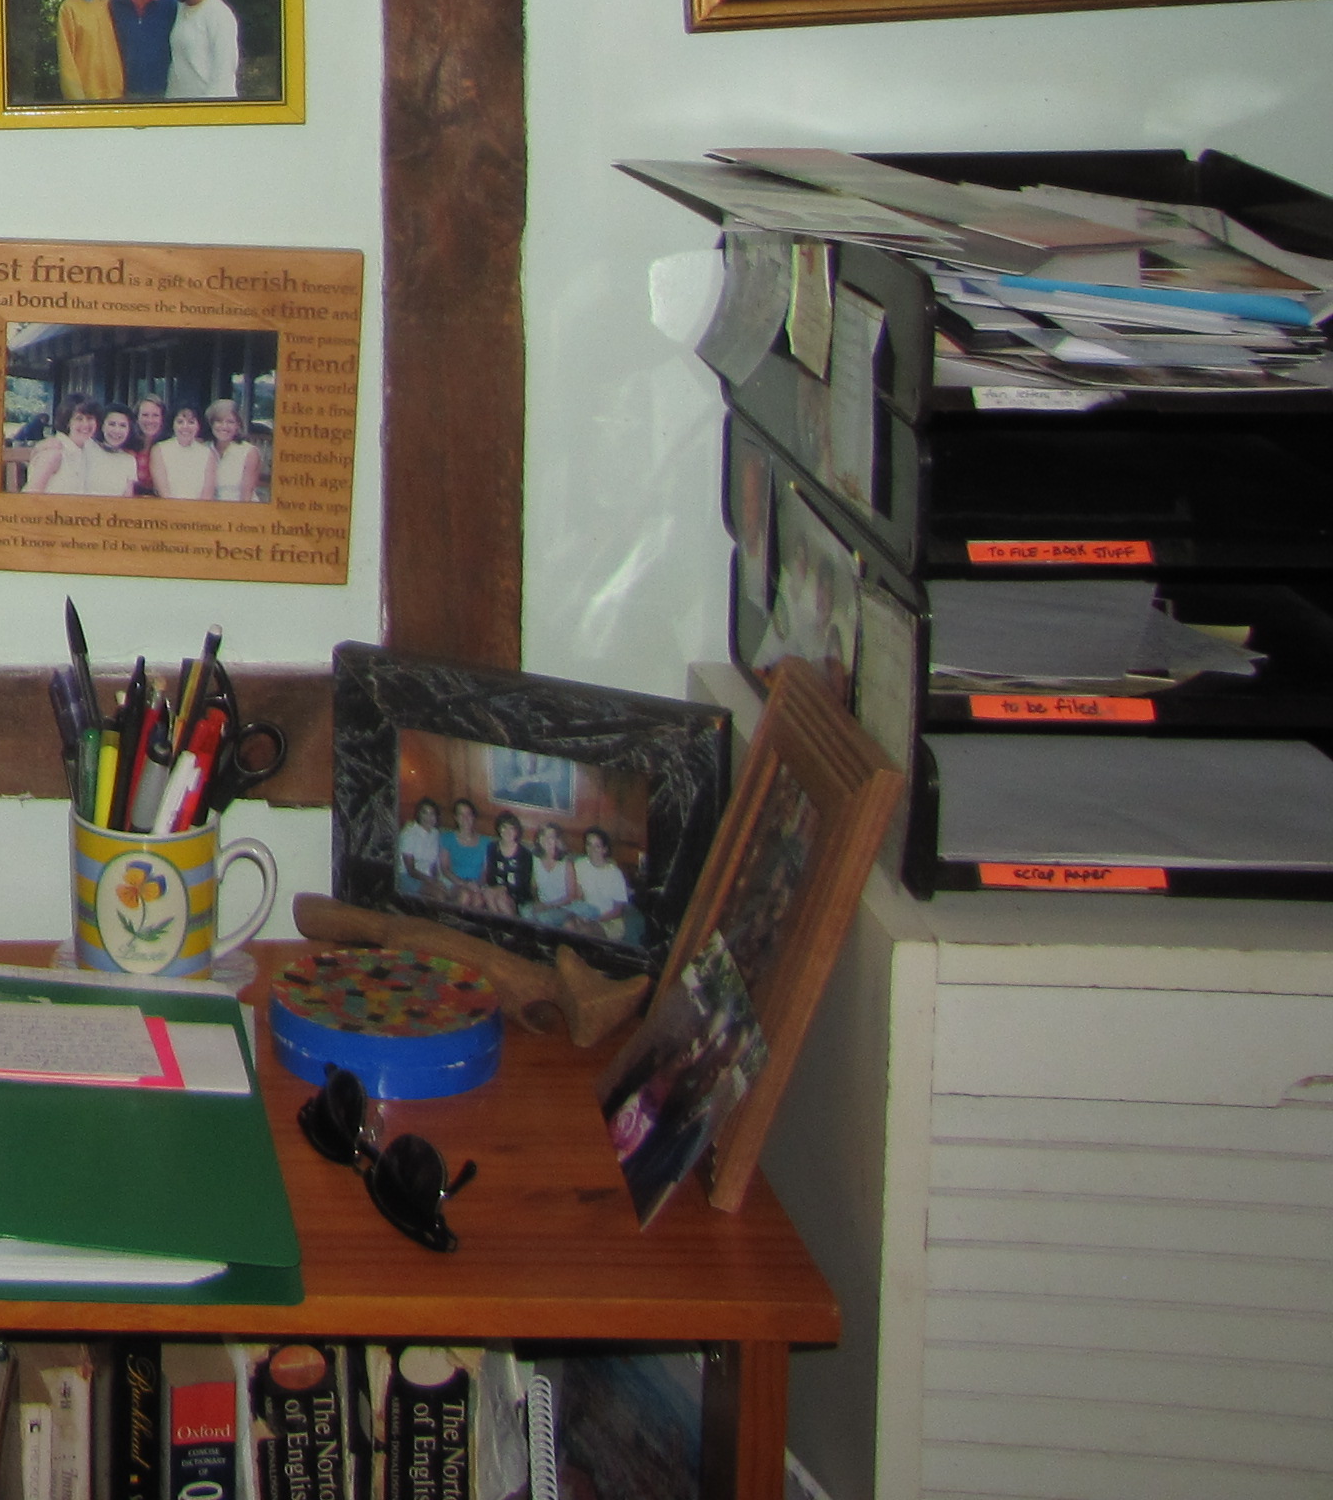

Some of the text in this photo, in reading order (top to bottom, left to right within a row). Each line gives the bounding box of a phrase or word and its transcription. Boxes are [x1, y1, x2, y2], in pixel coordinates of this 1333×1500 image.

[31, 255, 125, 284] friend
[129, 275, 140, 287] is
[145, 278, 153, 287] a
[158, 275, 183, 290] gift
[188, 278, 202, 289] to
[206, 267, 298, 292] cherish
[302, 281, 358, 295] forever.
[17, 290, 68, 309] bond
[71, 298, 98, 310] that
[102, 302, 150, 312] crosses
[155, 301, 176, 313] the
[180, 302, 258, 316] boundaries
[262, 303, 275, 316] of
[280, 301, 329, 320] time
[332, 308, 358, 321] and
[284, 332, 314, 343] Time
[285, 351, 357, 374] friend
[284, 382, 356, 395] in a world
[282, 402, 354, 417] Like a fine
[281, 423, 353, 446] vintage
[279, 451, 352, 469] friendship
[277, 474, 315, 487] with
[276, 497, 348, 515] have its ups
[20, 515, 43, 525] our
[45, 510, 102, 528] shared
[106, 514, 169, 531] dreams
[227, 522, 232, 533] I
[235, 523, 266, 534] don't
[271, 523, 316, 537] thank
[316, 527, 346, 542] you
[21, 536, 56, 548] know
[60, 538, 99, 550] where
[102, 540, 118, 551] I'd
[121, 540, 134, 551] be
[140, 541, 193, 554] without
[193, 546, 215, 558] my
[214, 540, 263, 561] best
[1010, 547, 1038, 558] FILE
[1092, 546, 1135, 558] STUFF
[1001, 698, 1100, 715] to be filed
[1013, 868, 1113, 883] scrap paper
[126, 1353, 157, 1469] Buckhead
[284, 1399, 306, 1429] of
[313, 1391, 335, 1440] The
[413, 1402, 436, 1430] of
[442, 1400, 466, 1441] The
[177, 1423, 232, 1439] Oxford
[187, 1447, 221, 1456] CONCISE
[181, 1456, 226, 1468] DICTIONARY
[198, 1468, 208, 1476] OF
